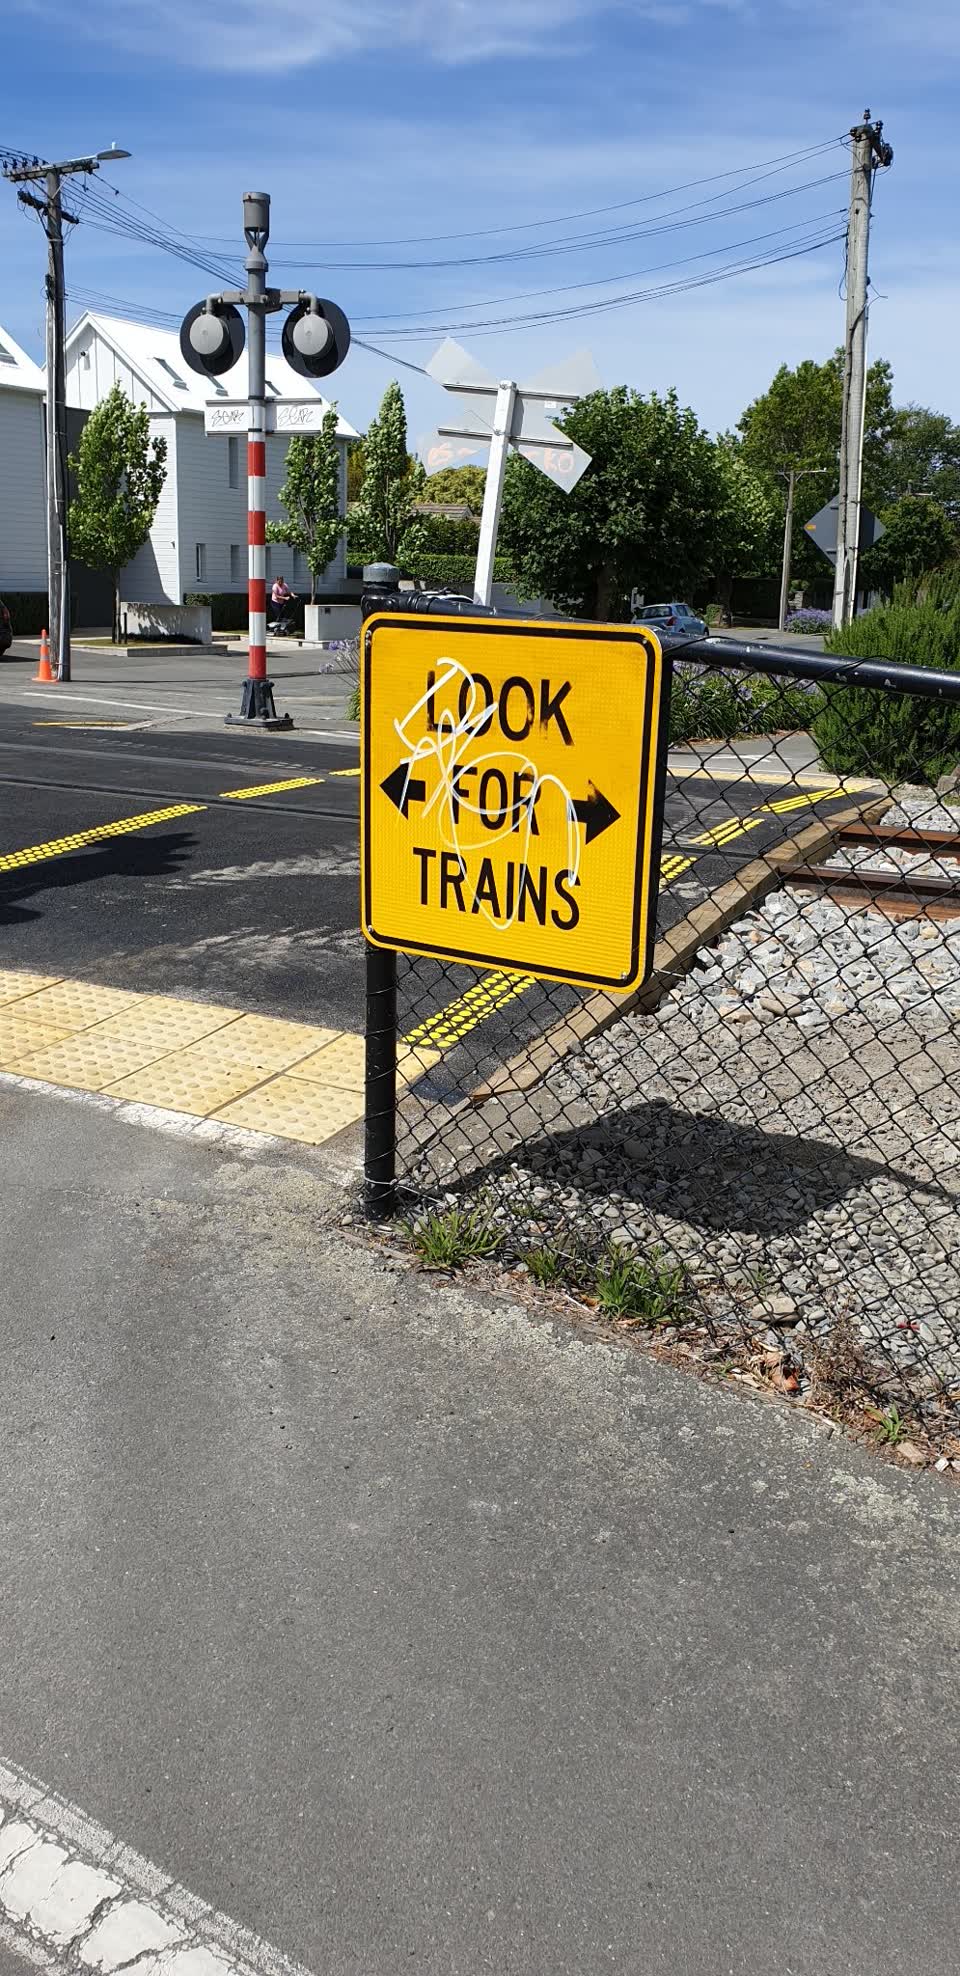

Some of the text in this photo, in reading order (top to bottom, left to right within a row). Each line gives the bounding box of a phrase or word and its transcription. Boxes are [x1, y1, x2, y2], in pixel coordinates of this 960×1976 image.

[426, 670, 574, 746] LOOK
[452, 764, 541, 836] FOR
[412, 847, 581, 930] TRAINS
